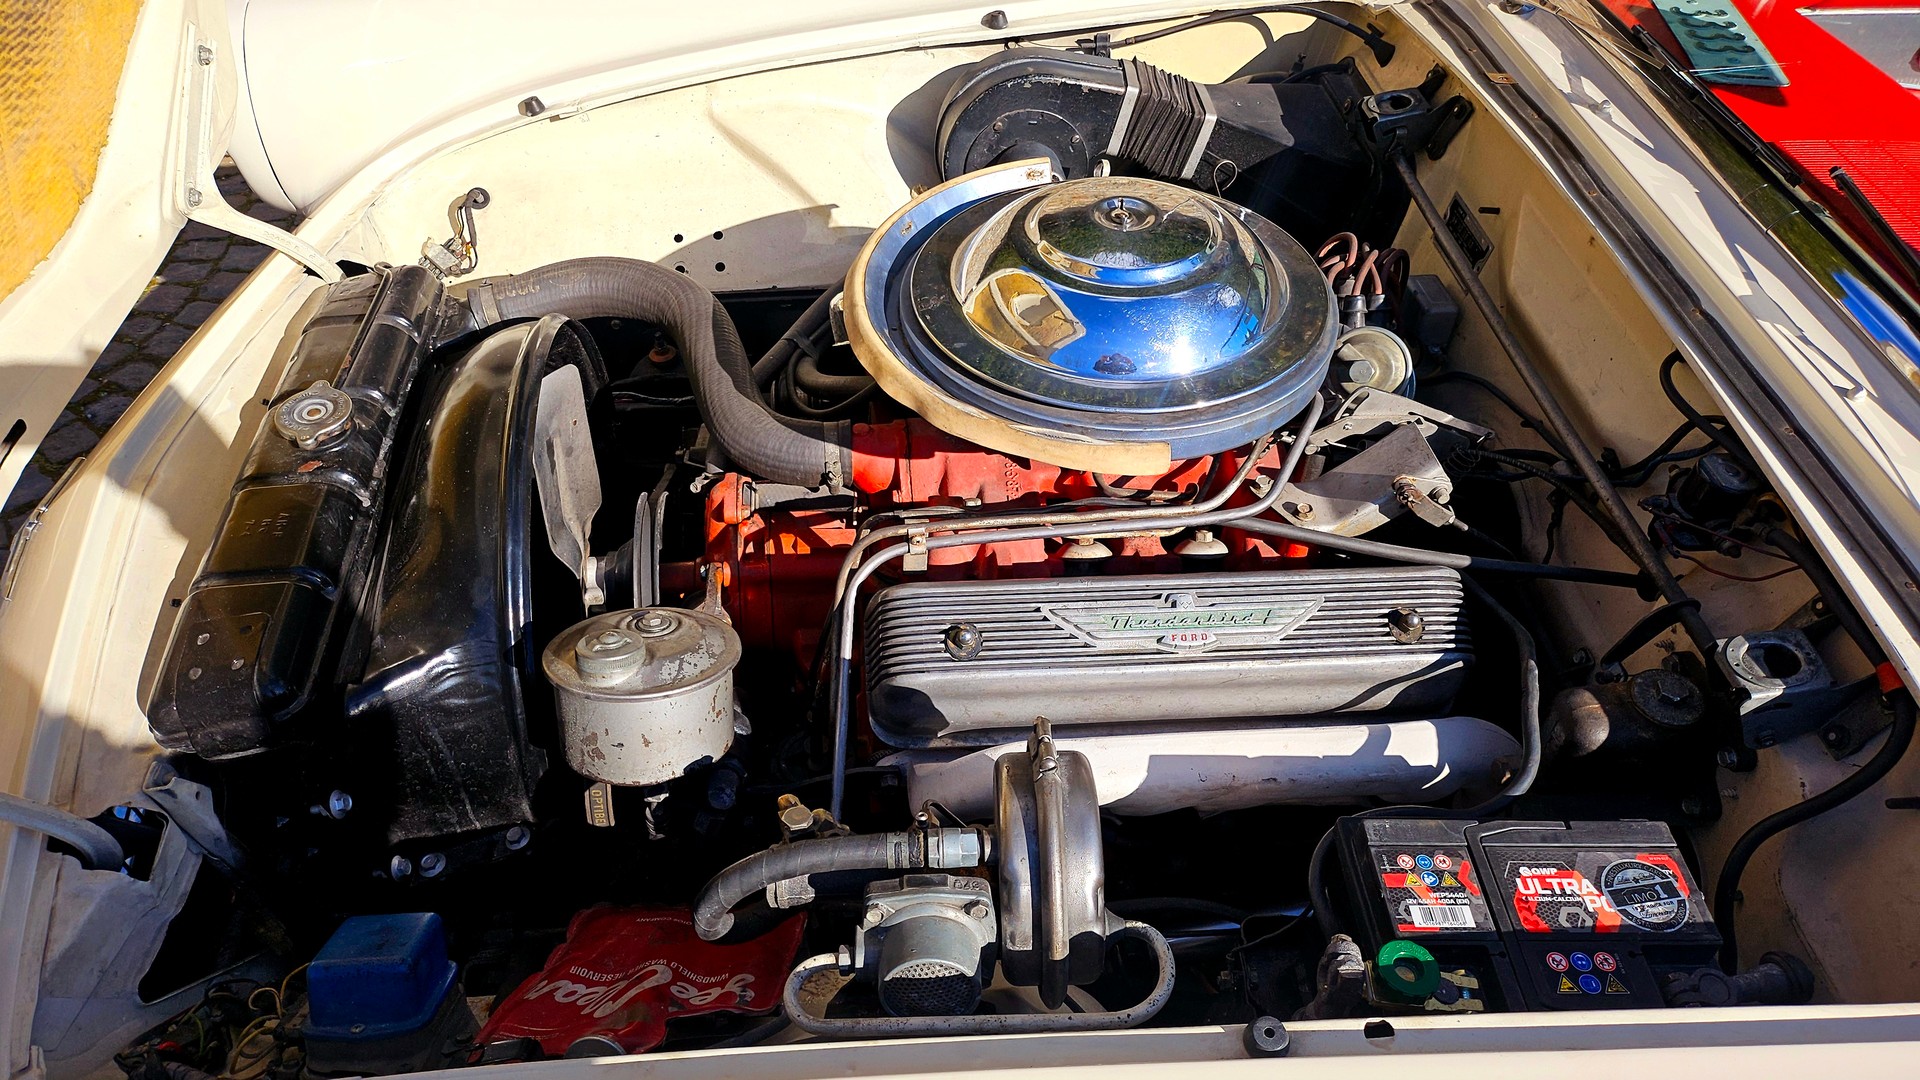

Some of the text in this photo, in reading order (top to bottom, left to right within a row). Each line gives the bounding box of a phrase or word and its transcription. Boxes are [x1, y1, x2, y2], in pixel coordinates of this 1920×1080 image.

[1111, 612, 1255, 629] Thunderbird
[1171, 633, 1208, 642] FORD
[1531, 867, 1558, 875] QWP
[1515, 877, 1600, 895] ULTRA
[1623, 890, 1658, 904] LIMO
[570, 965, 626, 982] RESERVOIR
[670, 961, 729, 983] WINDSHIELD
